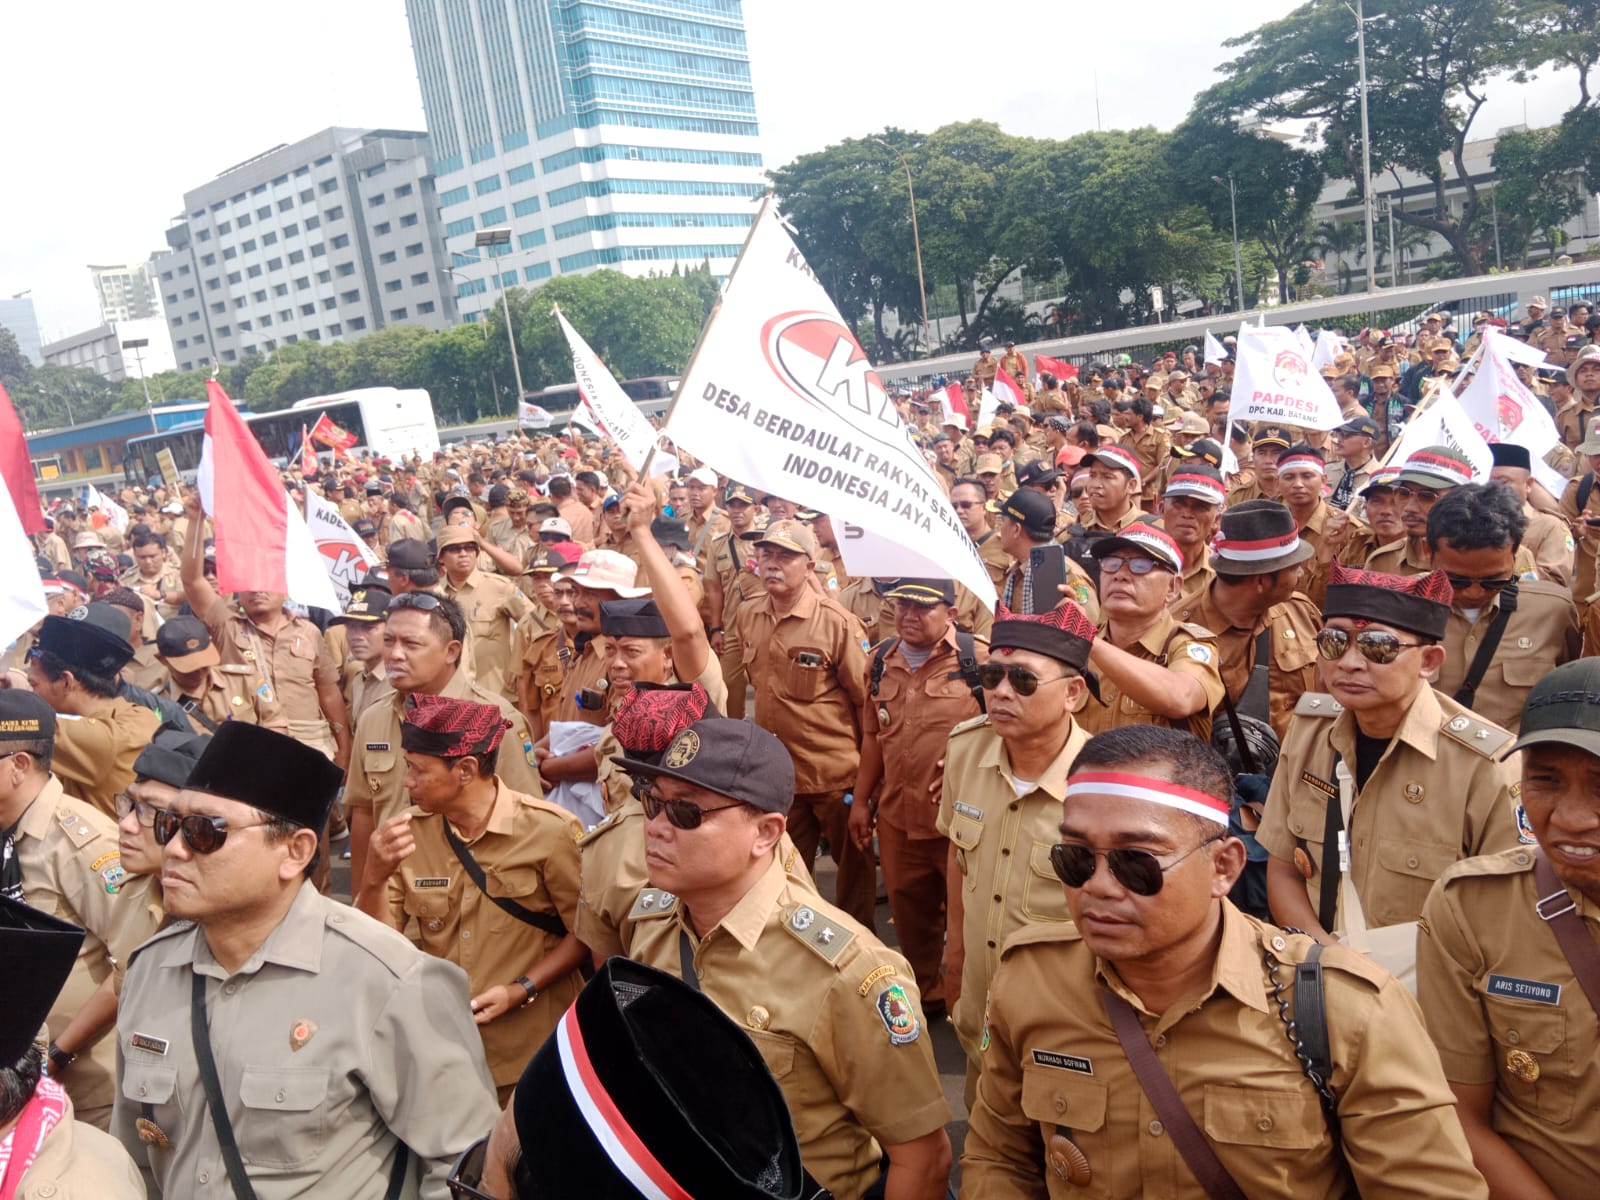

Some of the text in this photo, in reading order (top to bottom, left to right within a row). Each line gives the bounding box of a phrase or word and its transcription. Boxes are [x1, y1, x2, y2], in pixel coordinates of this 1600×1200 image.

[1248, 405, 1318, 423] DPC KAB. BATANG
[1251, 391, 1319, 414] PAPDESI
[702, 382, 752, 420] DESA
[753, 409, 865, 463] BERDAULAT
[866, 452, 929, 503] RAKYAT
[782, 452, 932, 534] INDONESIA JAYA
[1495, 980, 1552, 998] ARIS SETIYONO
